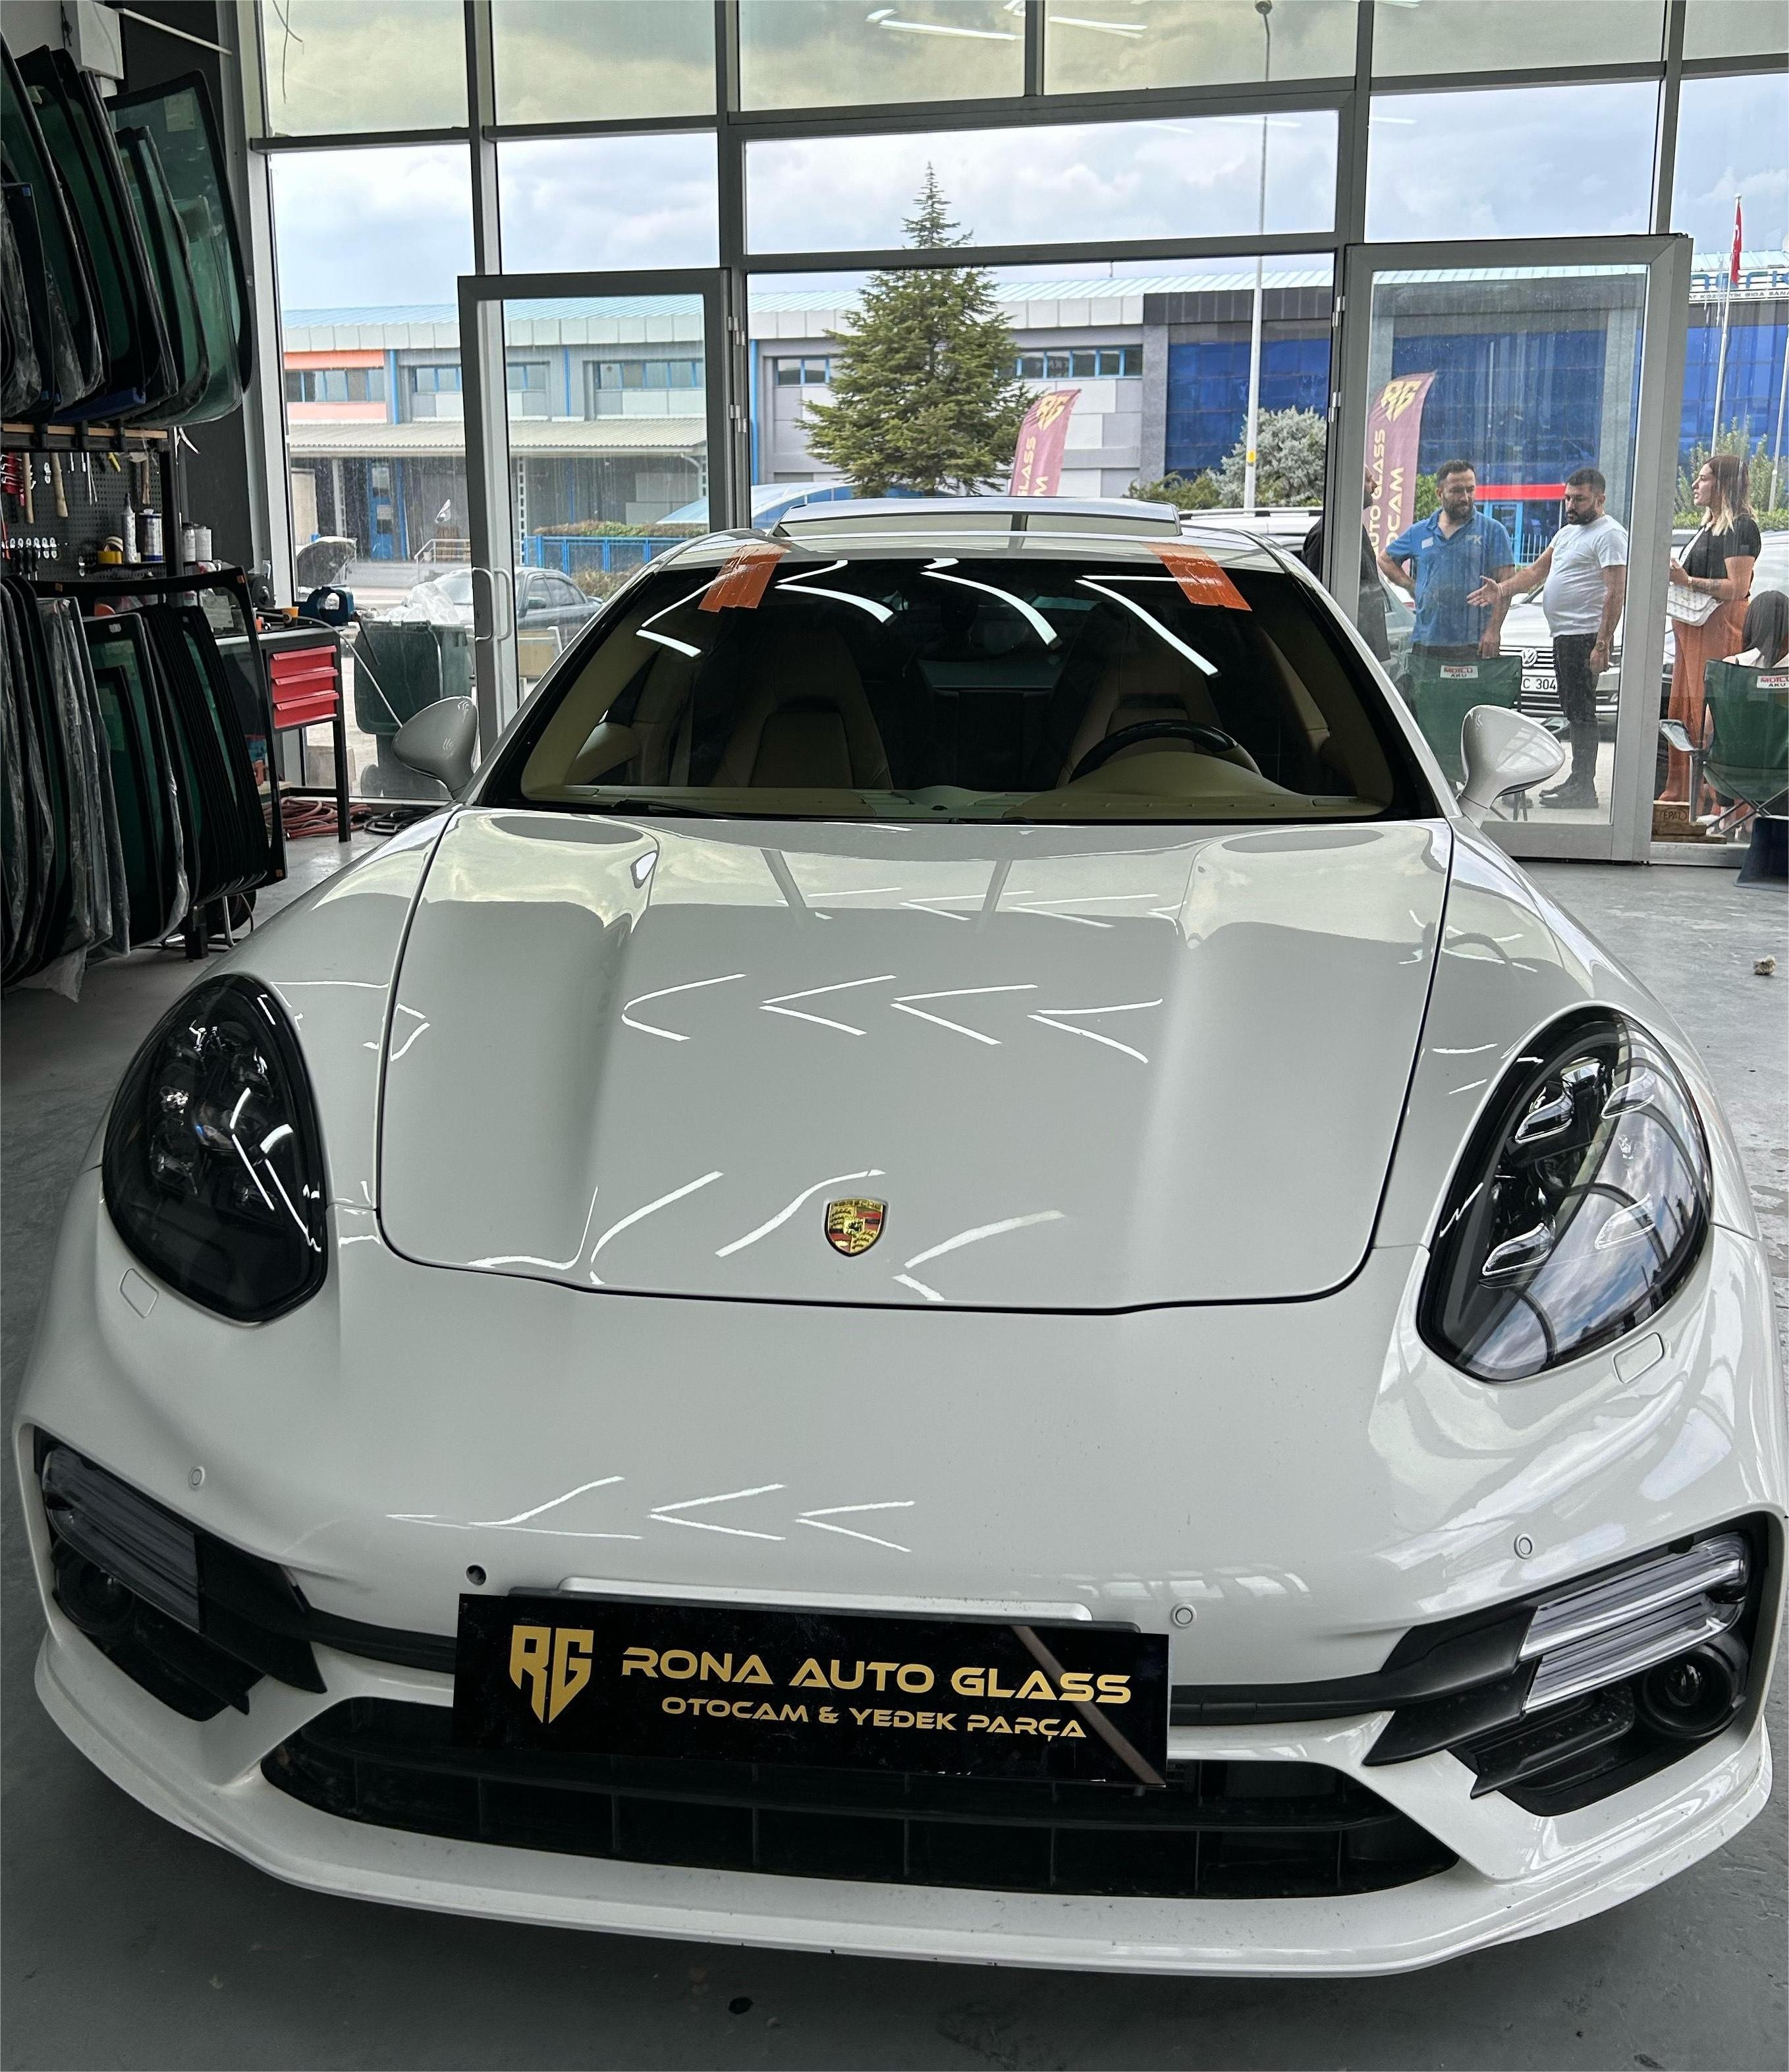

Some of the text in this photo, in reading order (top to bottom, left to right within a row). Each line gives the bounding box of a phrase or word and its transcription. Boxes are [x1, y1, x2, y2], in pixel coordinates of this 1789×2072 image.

[1381, 379, 1422, 422] RG
[1536, 679, 1556, 690] 304
[1664, 810, 1684, 820] EPAL
[509, 1625, 595, 1723] RG
[622, 1646, 1131, 1704] RONA AUTO GLASS
[661, 1696, 1087, 1742] OTOCAM & YEDEK PARÇA
